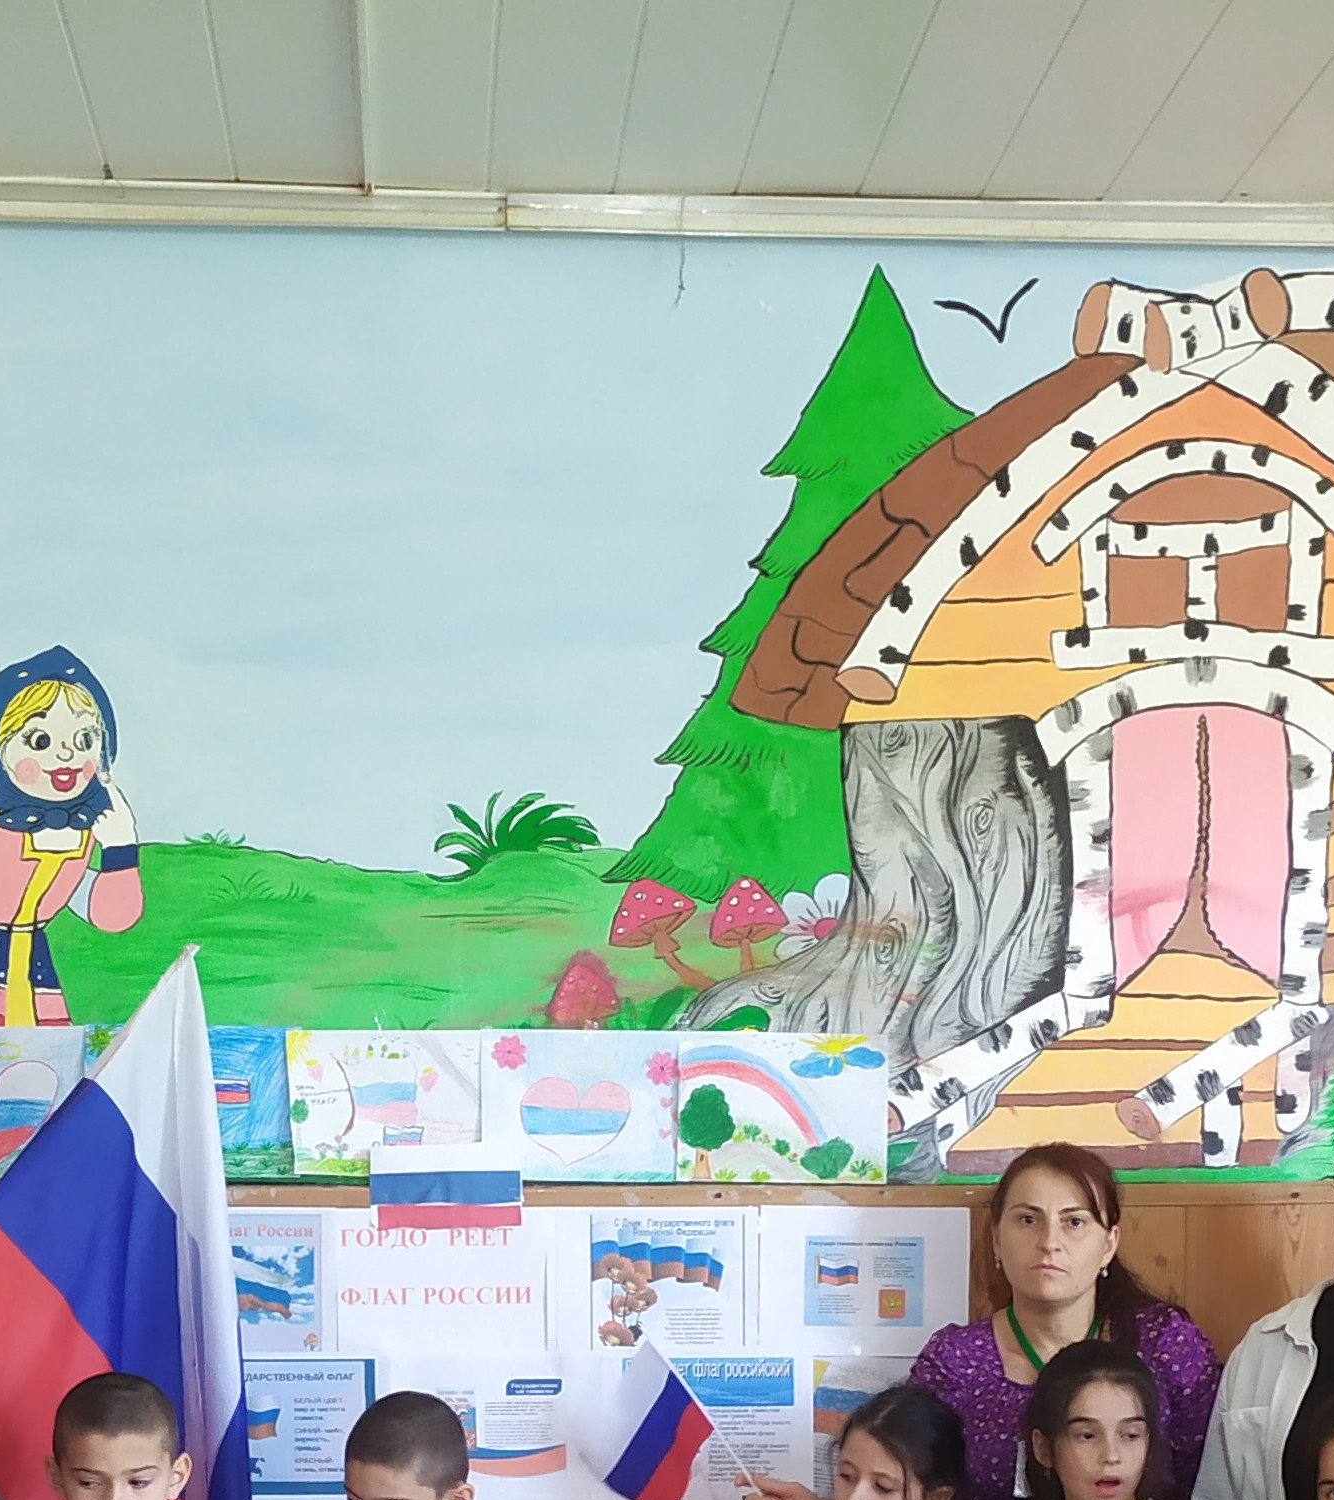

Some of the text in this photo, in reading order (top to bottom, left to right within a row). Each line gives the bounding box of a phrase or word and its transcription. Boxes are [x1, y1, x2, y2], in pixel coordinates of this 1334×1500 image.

[256, 1223, 314, 1238] России
[340, 1227, 514, 1250] ГОРДО РЕЕТ
[340, 1286, 533, 1306] ФЛАГ РОССИИ
[326, 1373, 356, 1382] ФЛАГ
[692, 1357, 722, 1383] флаг
[724, 1357, 792, 1382] российский
